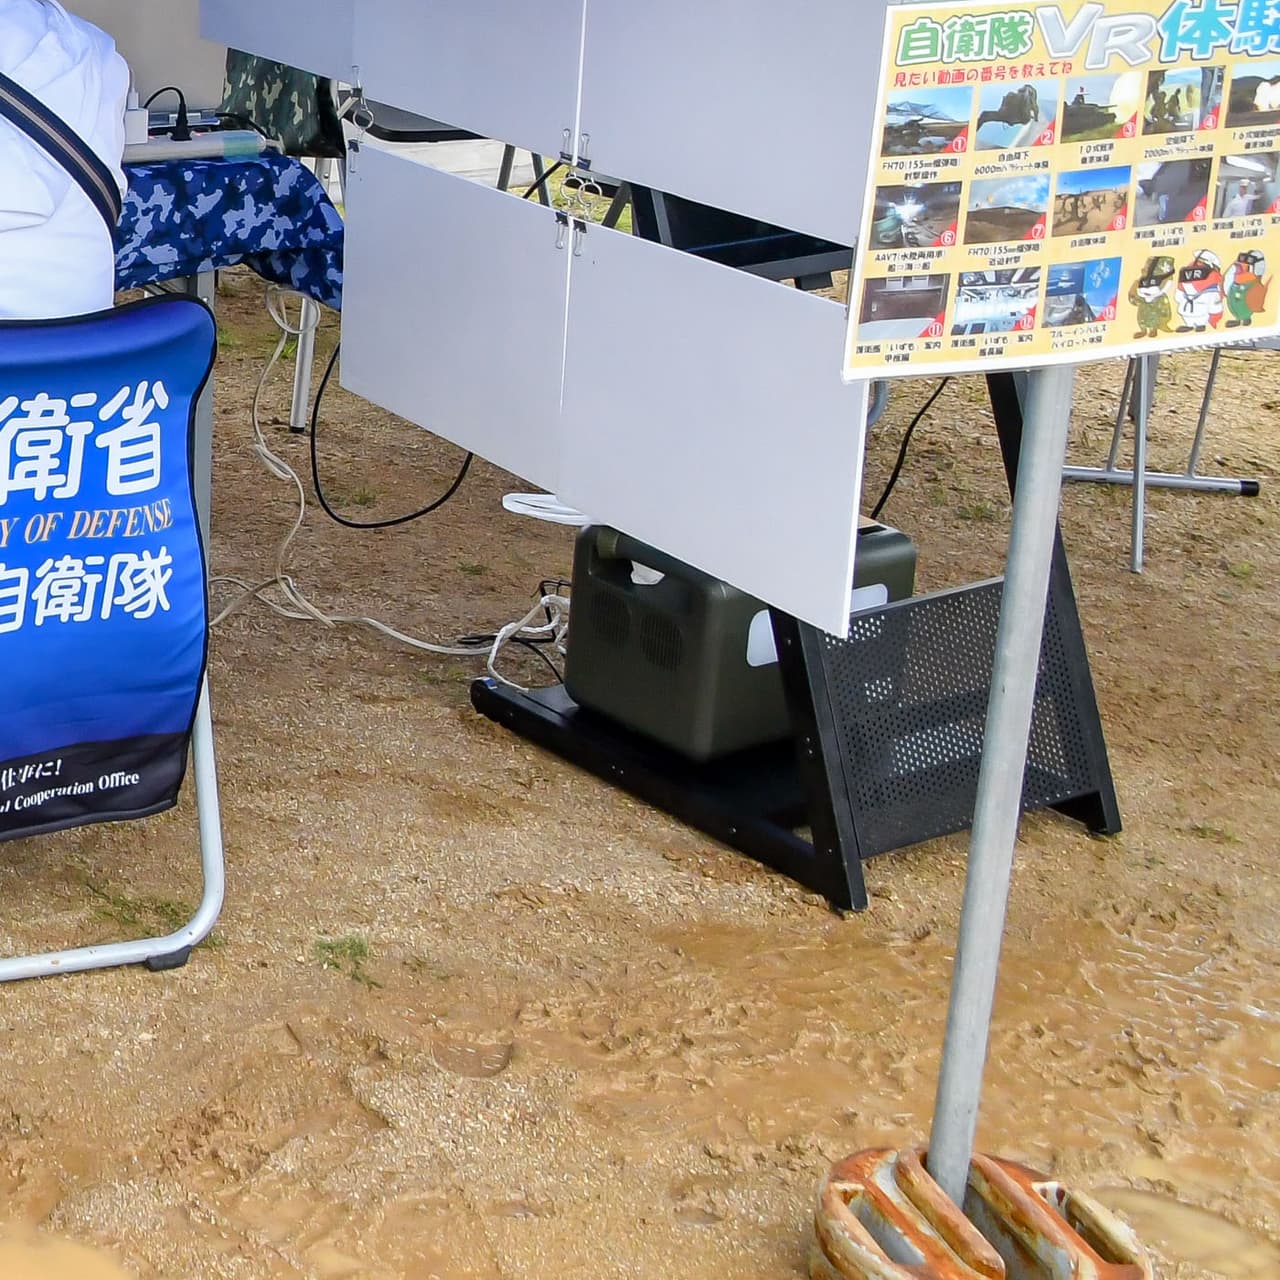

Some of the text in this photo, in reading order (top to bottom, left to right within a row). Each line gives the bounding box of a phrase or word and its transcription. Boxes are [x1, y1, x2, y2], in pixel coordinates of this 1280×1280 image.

[894, 62, 1072, 87] 見たい動画の番号を教えてね
[1185, 269, 1202, 279] VR
[24, 512, 64, 544] OF
[67, 498, 174, 539] DEFENSE
[14, 781, 93, 811] Cooperation
[98, 771, 140, 790] Office
